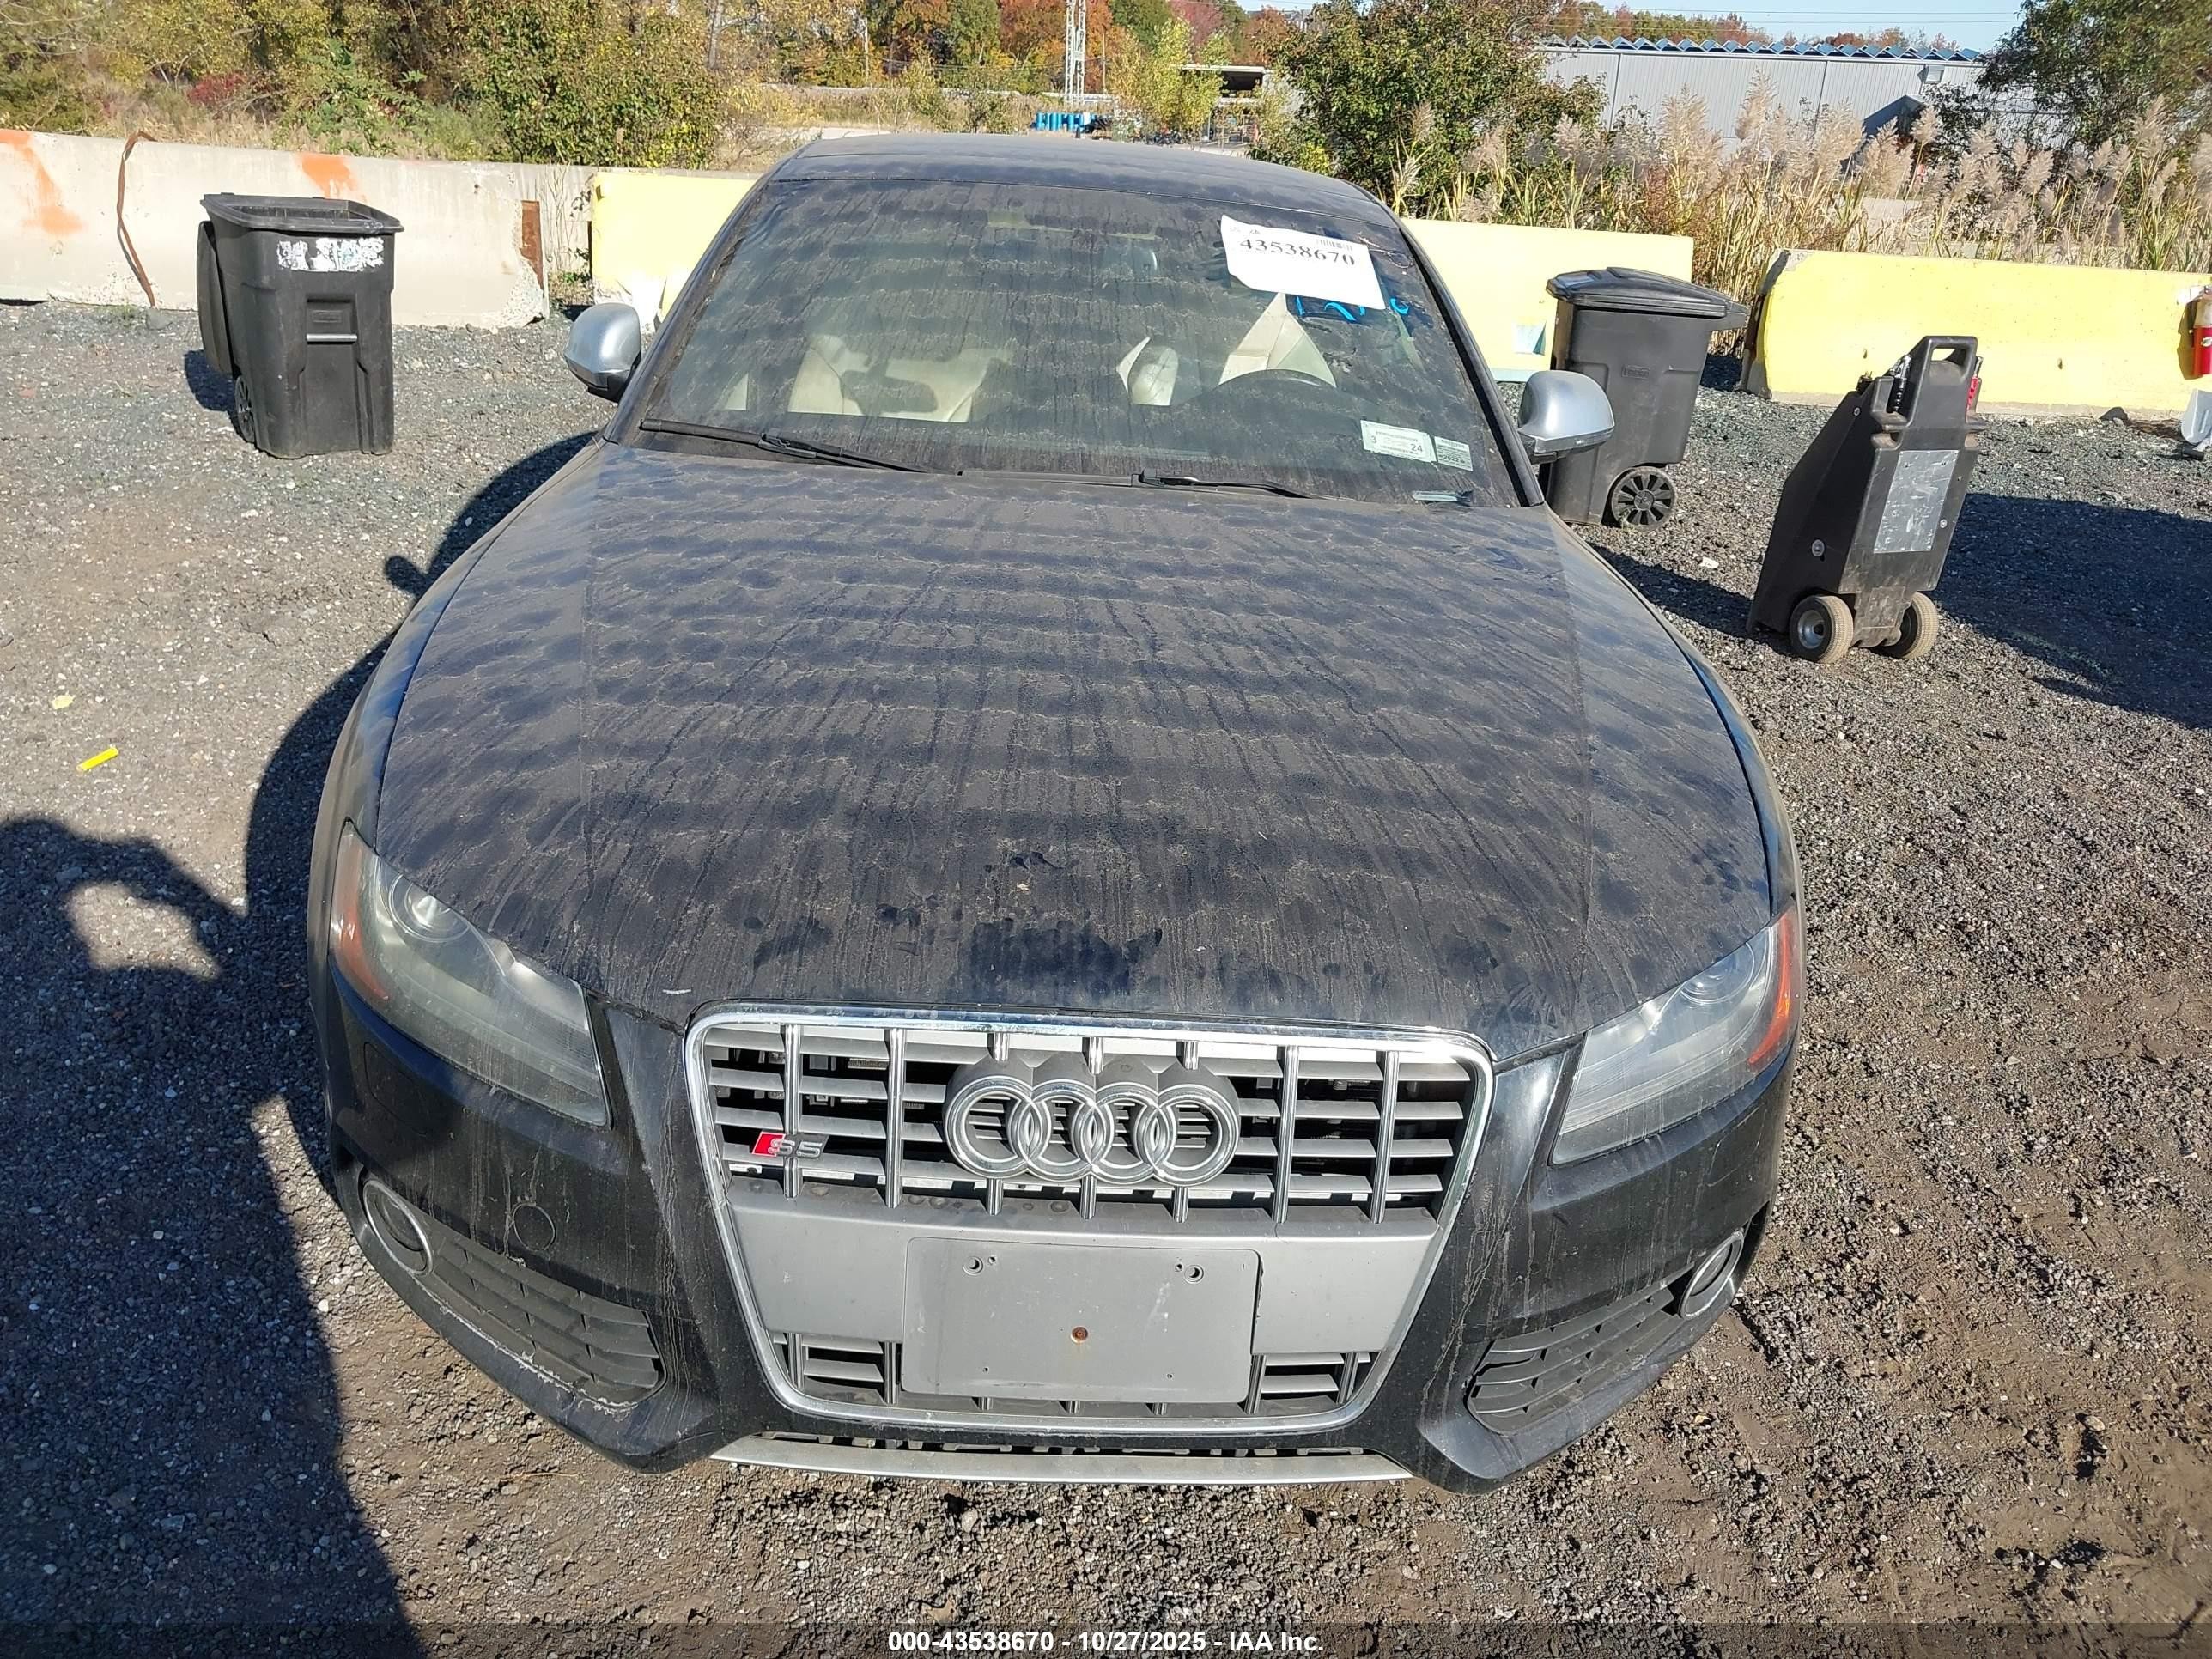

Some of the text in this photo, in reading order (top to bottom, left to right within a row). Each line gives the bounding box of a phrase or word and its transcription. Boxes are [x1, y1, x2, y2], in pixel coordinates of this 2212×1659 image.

[1239, 238, 1355, 266] 43538670
[1370, 434, 1377, 444] 3
[1410, 443, 1423, 453] 24
[767, 1138, 823, 1158] S5
